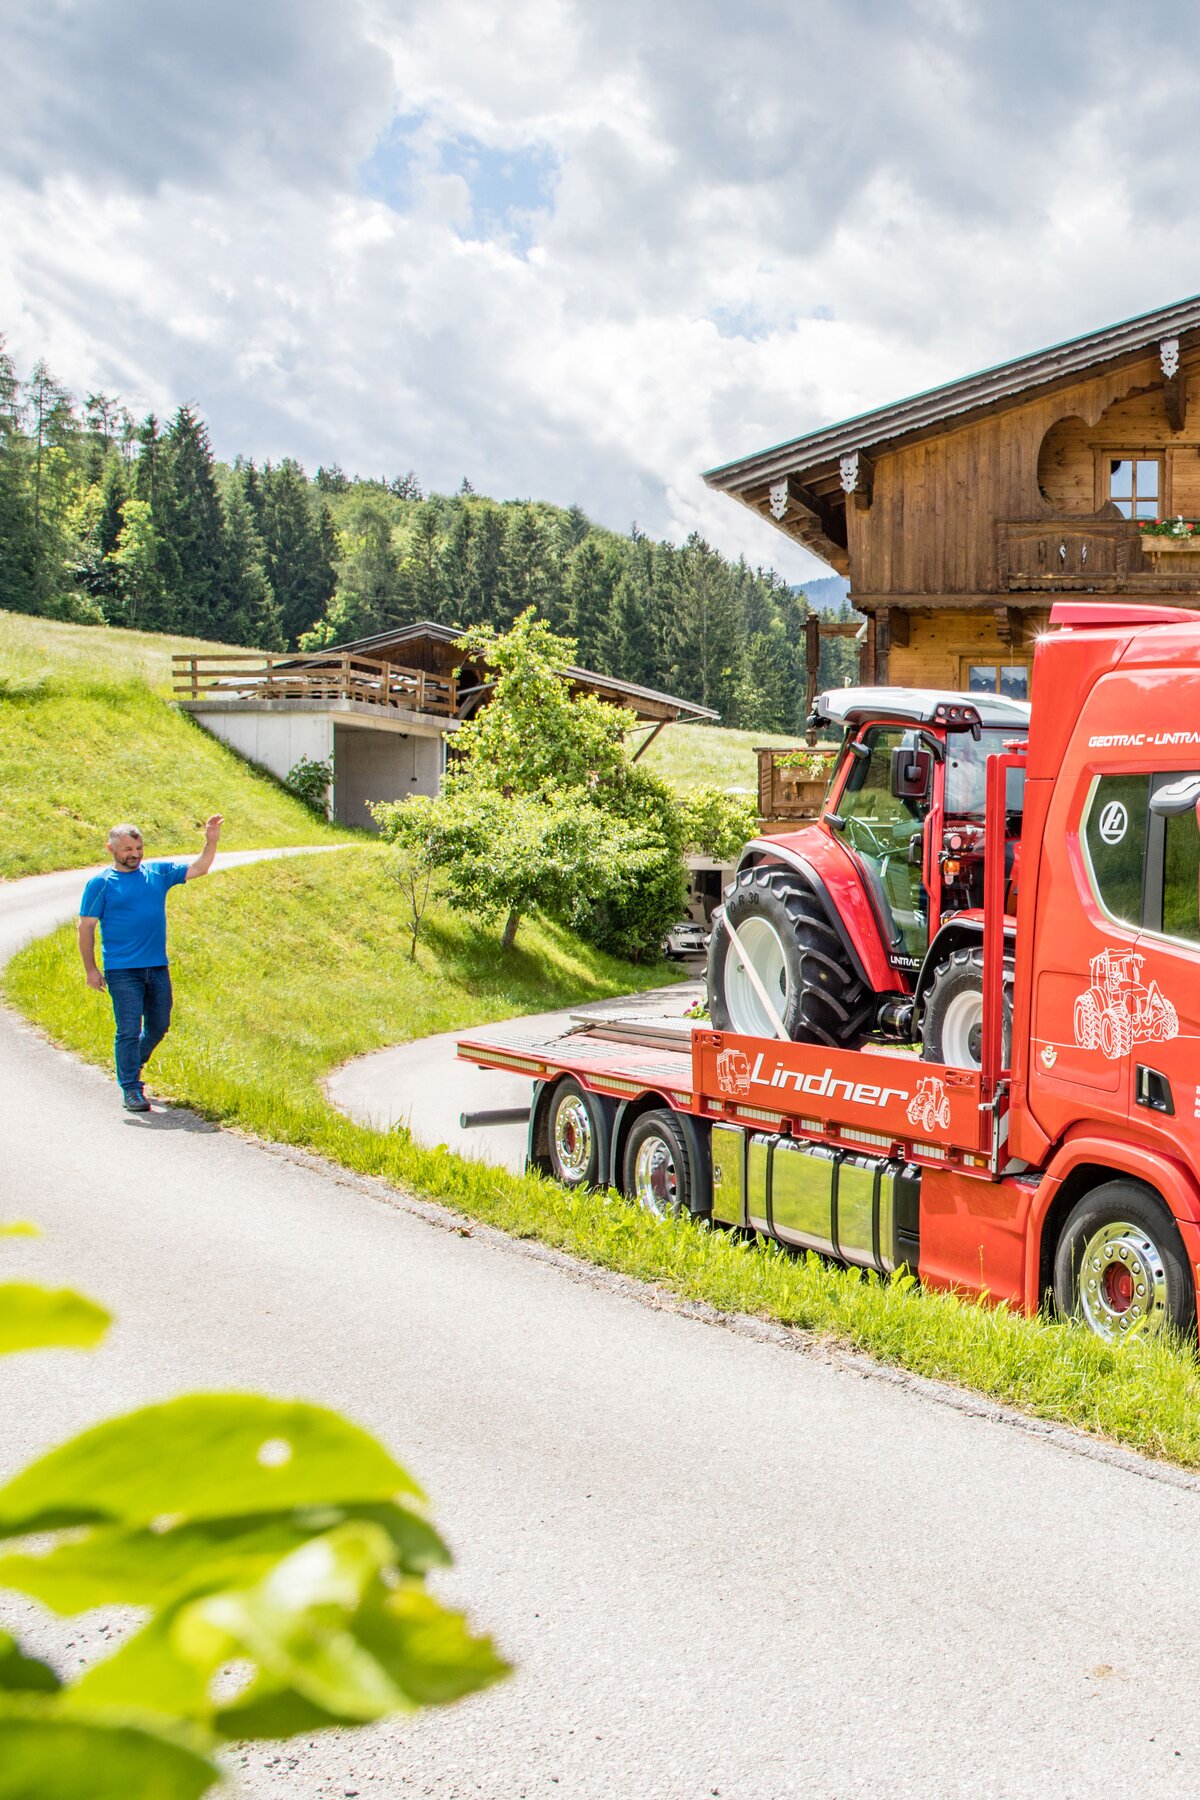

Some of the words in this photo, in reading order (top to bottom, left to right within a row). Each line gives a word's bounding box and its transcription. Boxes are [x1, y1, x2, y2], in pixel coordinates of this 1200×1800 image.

[1088, 733, 1146, 748] GEOTRAC
[748, 891, 759, 904] 30
[890, 955, 920, 967] LINTRAC
[750, 1052, 909, 1108] Lindner
